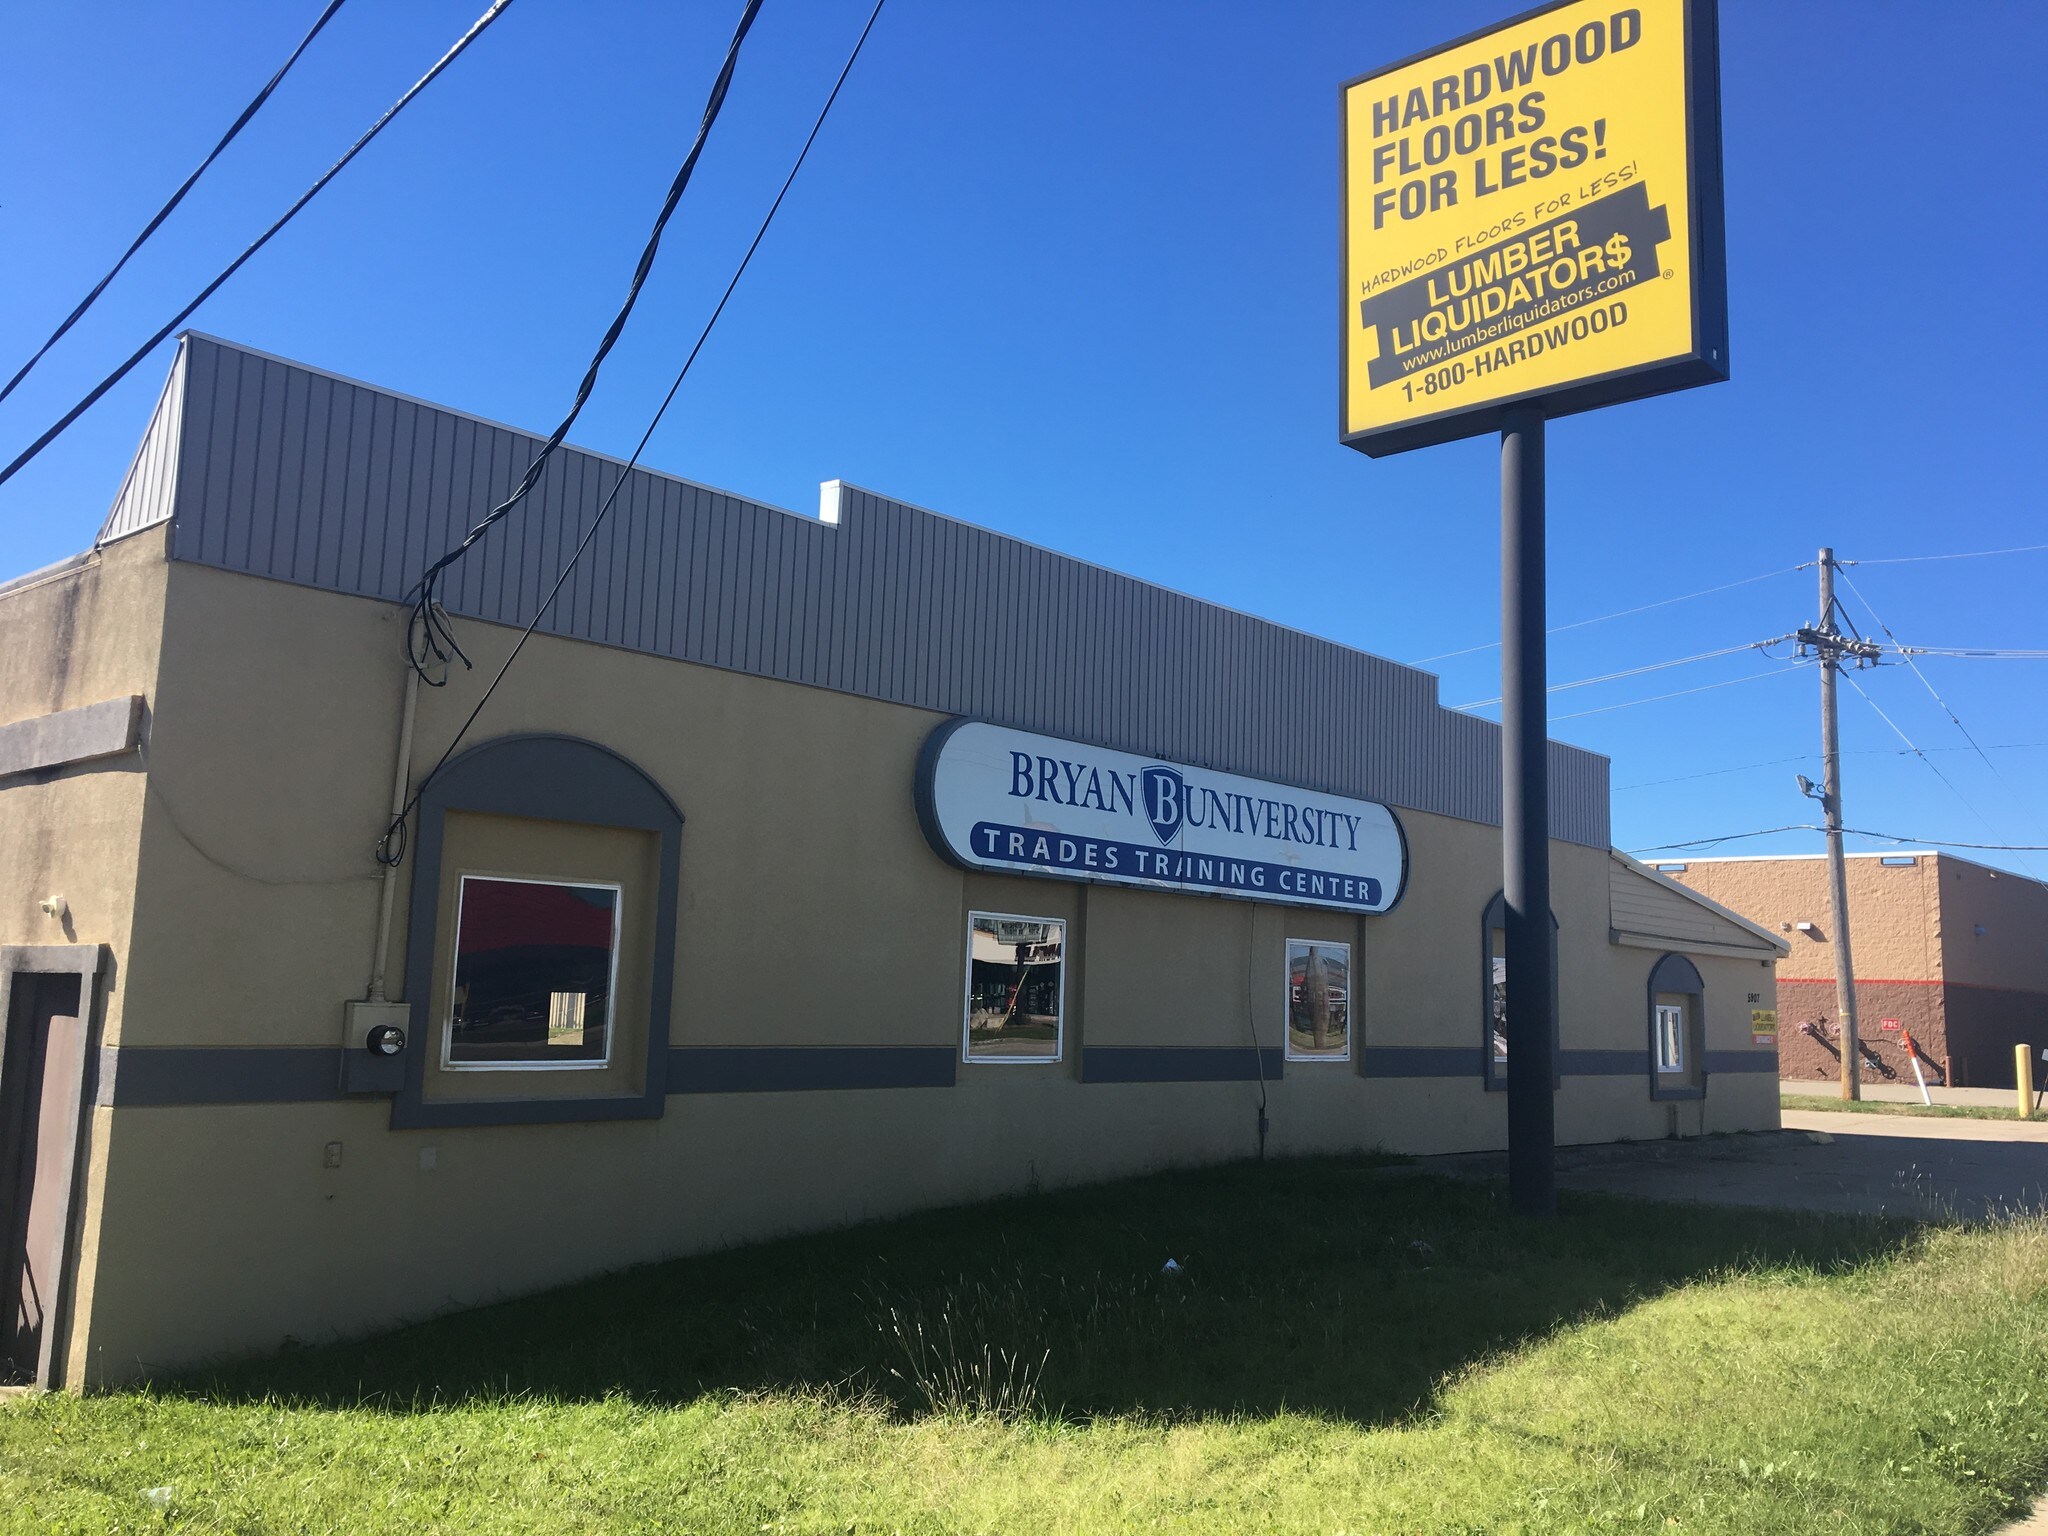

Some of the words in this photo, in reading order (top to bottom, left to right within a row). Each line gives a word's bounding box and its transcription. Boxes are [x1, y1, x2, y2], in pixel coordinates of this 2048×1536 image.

[1373, 8, 1641, 138] HARDWOOD
[1373, 91, 1546, 184] FLOORS
[1374, 169, 1458, 230] FOR
[1475, 118, 1607, 198] LESS!
[1361, 248, 1448, 295] HARDWOOD
[1455, 215, 1527, 253] FLOORS
[1534, 193, 1571, 219] FOR
[1579, 160, 1638, 200] LESS!
[1427, 219, 1581, 308] LUMBER
[1401, 301, 1628, 403] 1-800-HARDWOOD
[1402, 269, 1636, 371] www.lumberliquidators.com
[1008, 750, 1137, 816] BRYAN
[1151, 774, 1178, 826] B
[1183, 784, 1362, 851] UNIVERSITY
[983, 828, 1119, 869] TRADES
[1279, 870, 1371, 900] CENTER
